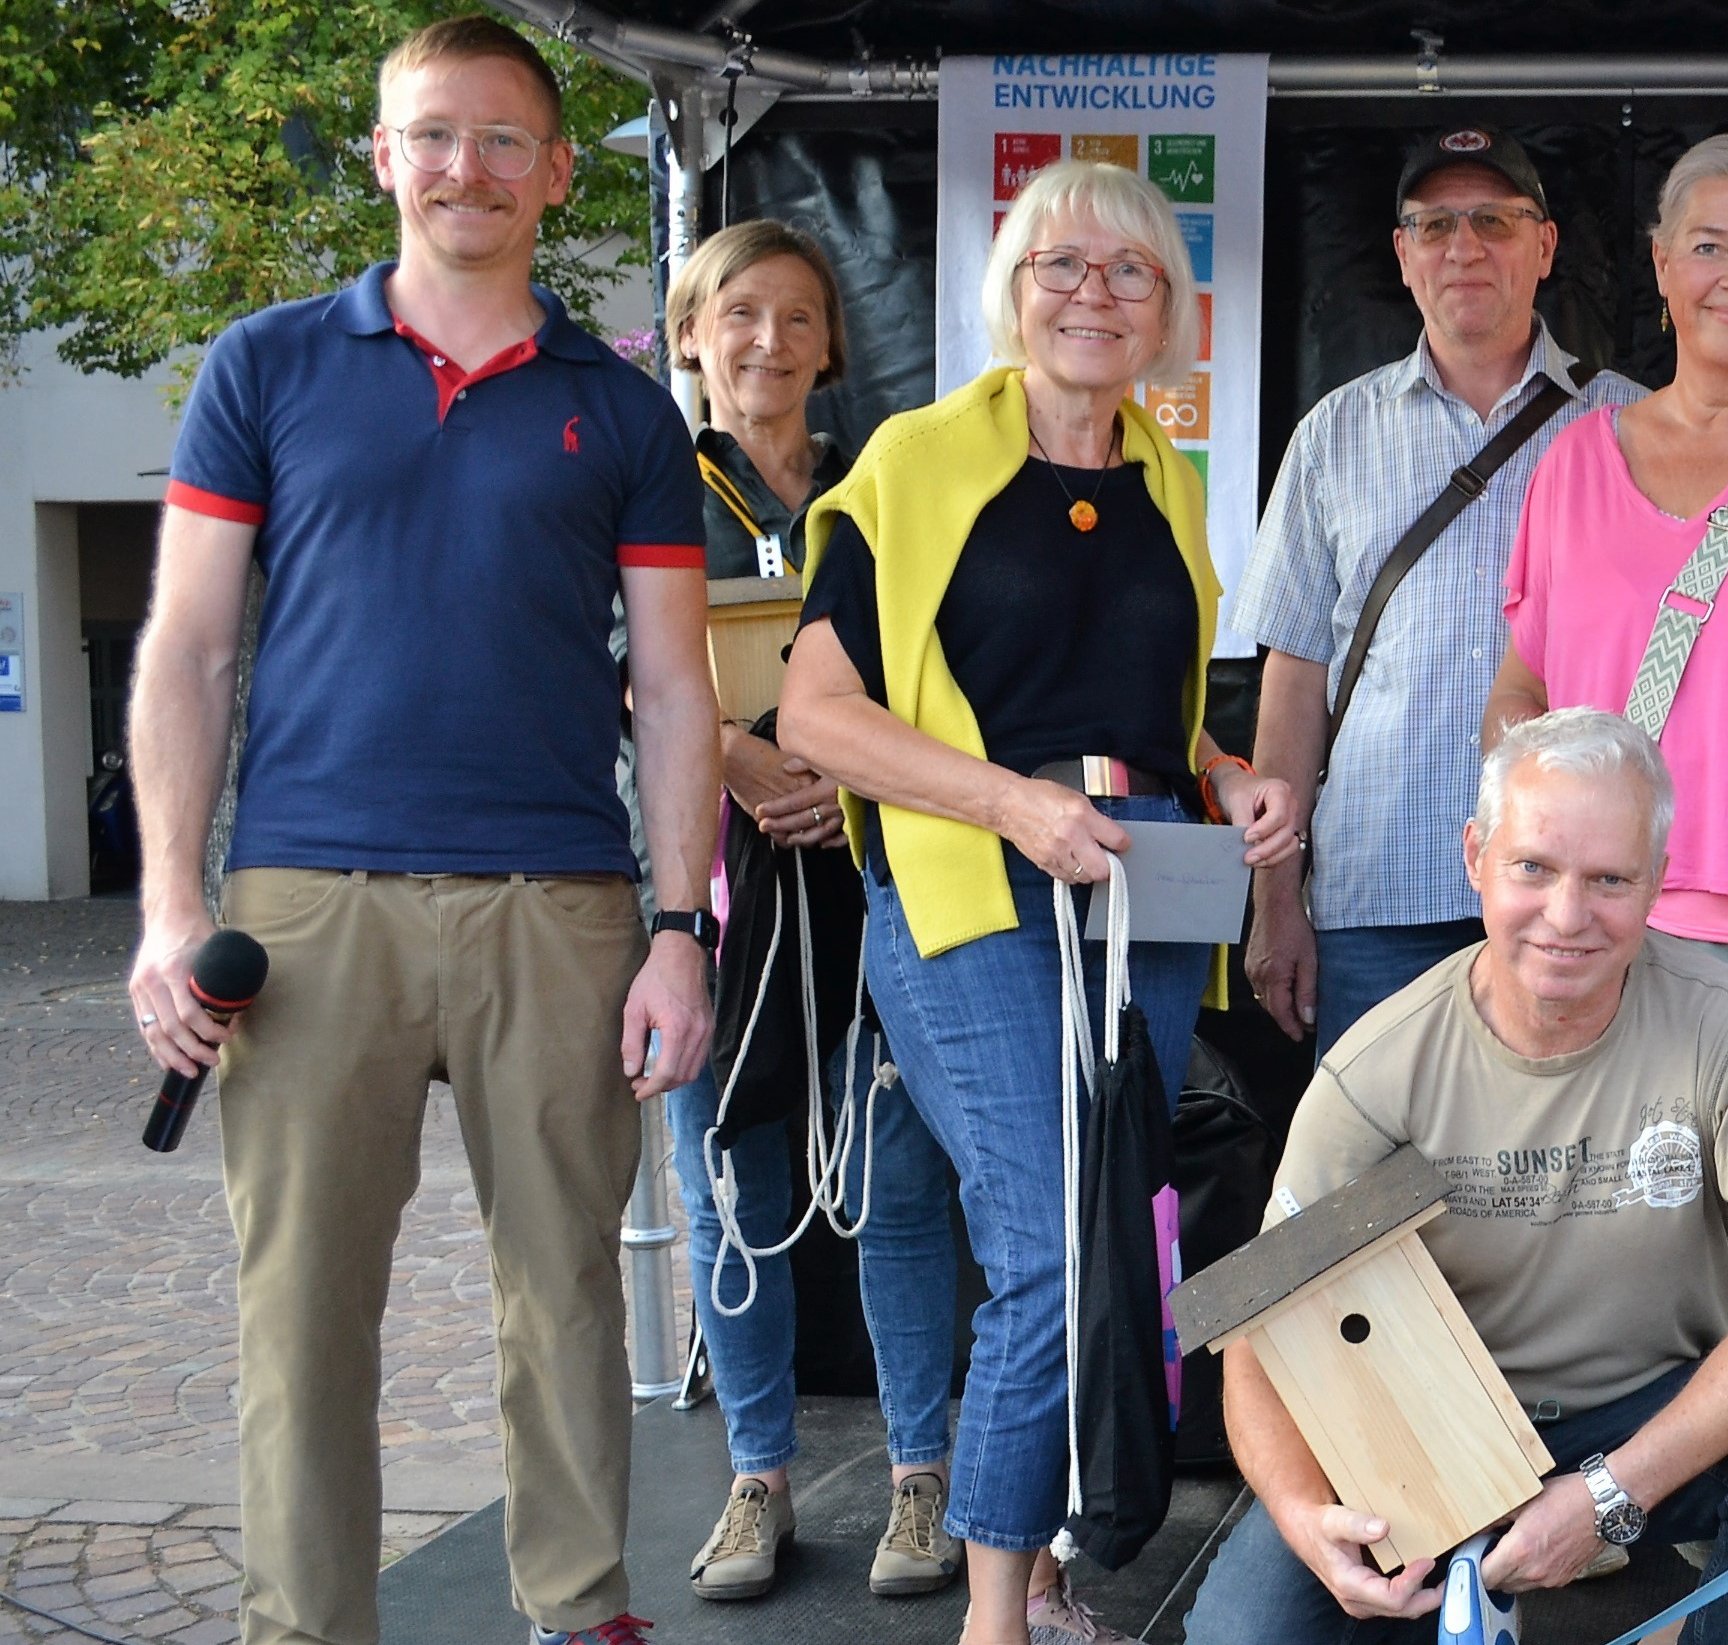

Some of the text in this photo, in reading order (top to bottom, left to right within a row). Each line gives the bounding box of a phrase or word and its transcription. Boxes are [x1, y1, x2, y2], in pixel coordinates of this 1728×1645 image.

[992, 54, 1216, 77] NACHHALTIGE
[994, 83, 1215, 109] ENTWICKLUNG
[1002, 138, 1007, 154] 1
[1077, 139, 1085, 155] 2
[1154, 139, 1162, 155] 3
[1433, 1155, 1492, 1167] FROM EAST TO
[1497, 1136, 1592, 1176] SUNSET
[1465, 1184, 1476, 1193] ON
[1479, 1185, 1495, 1195] THE
[1470, 1197, 1486, 1206] AND
[1492, 1197, 1512, 1208] LAT
[1449, 1206, 1536, 1219] ROADS OF AMERICA
